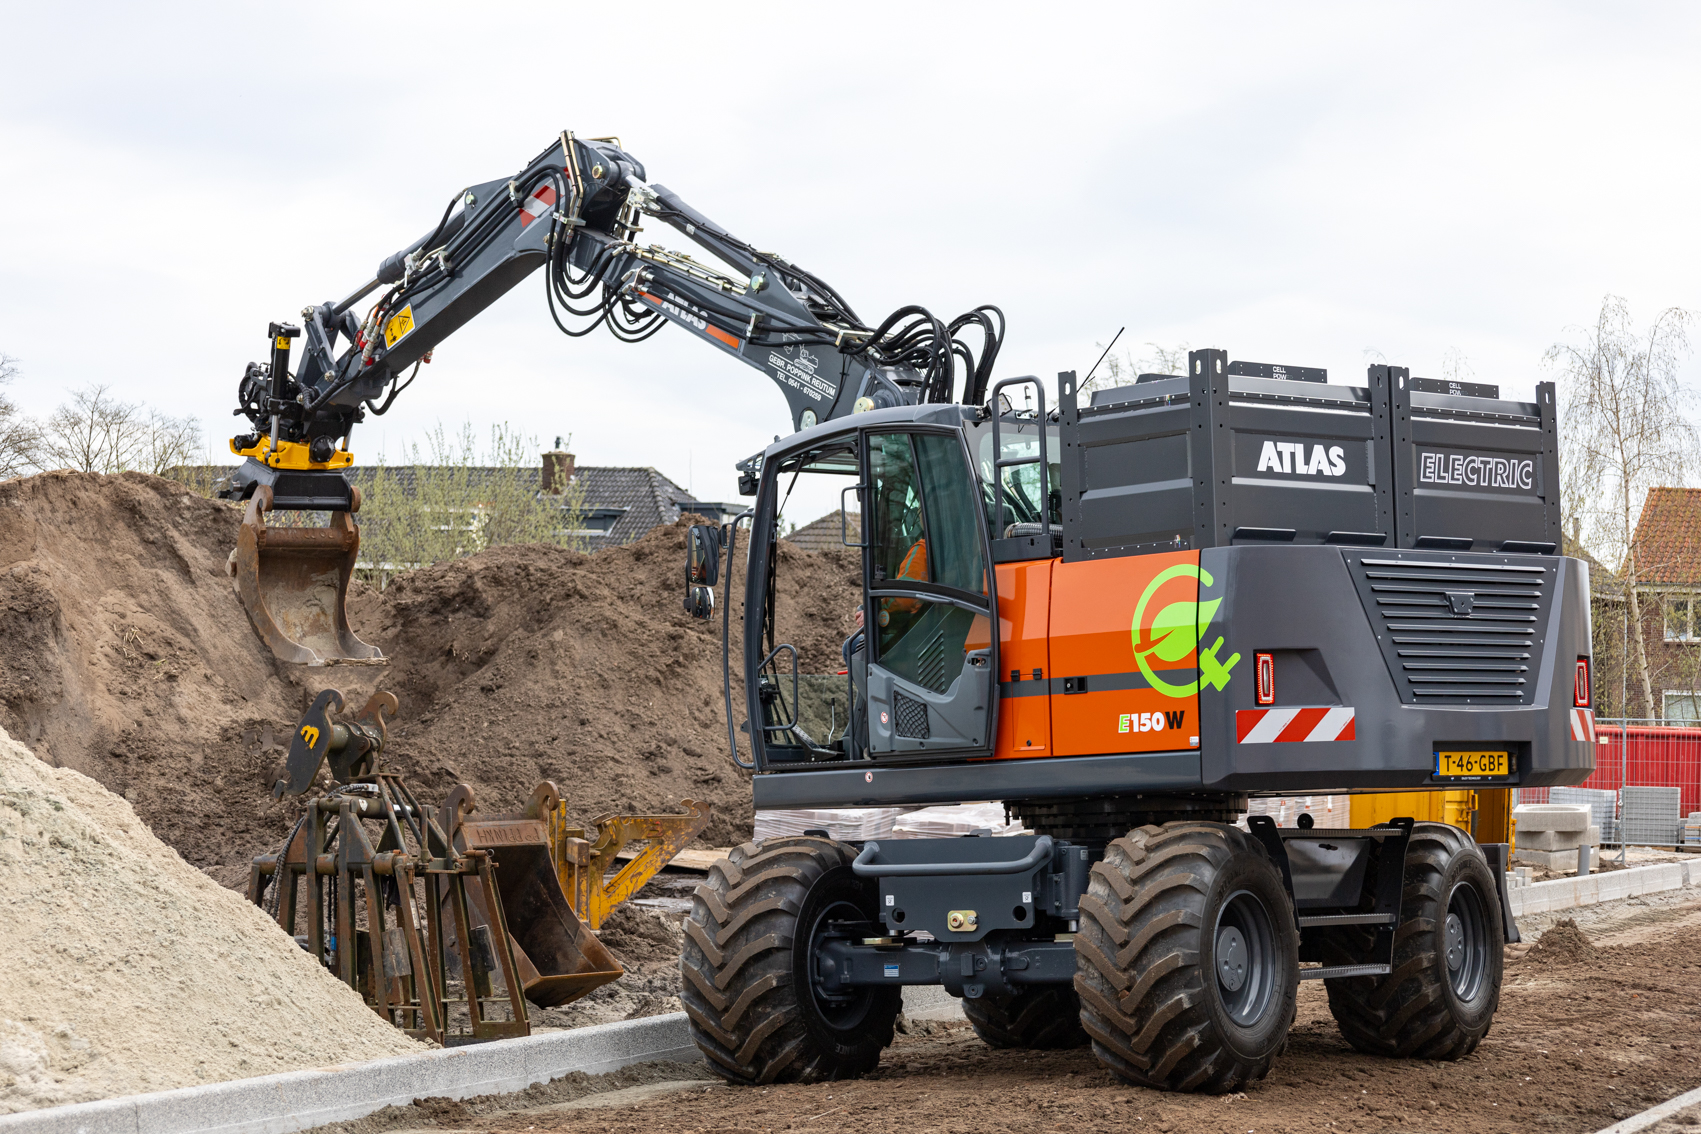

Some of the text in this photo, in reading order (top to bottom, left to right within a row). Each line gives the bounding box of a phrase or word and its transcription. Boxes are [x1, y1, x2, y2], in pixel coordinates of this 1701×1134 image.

[661, 292, 708, 330] ATLAS
[769, 354, 836, 396] GEBR. POPPINK REUTUM
[1272, 366, 1287, 374] CELL
[787, 378, 800, 390] 0541
[803, 386, 822, 401] 670259
[1449, 382, 1462, 390] CELL
[1257, 440, 1346, 477] ATLAS
[1420, 452, 1533, 490] ELECTRIC
[1444, 755, 1504, 772] T-46-GBF
